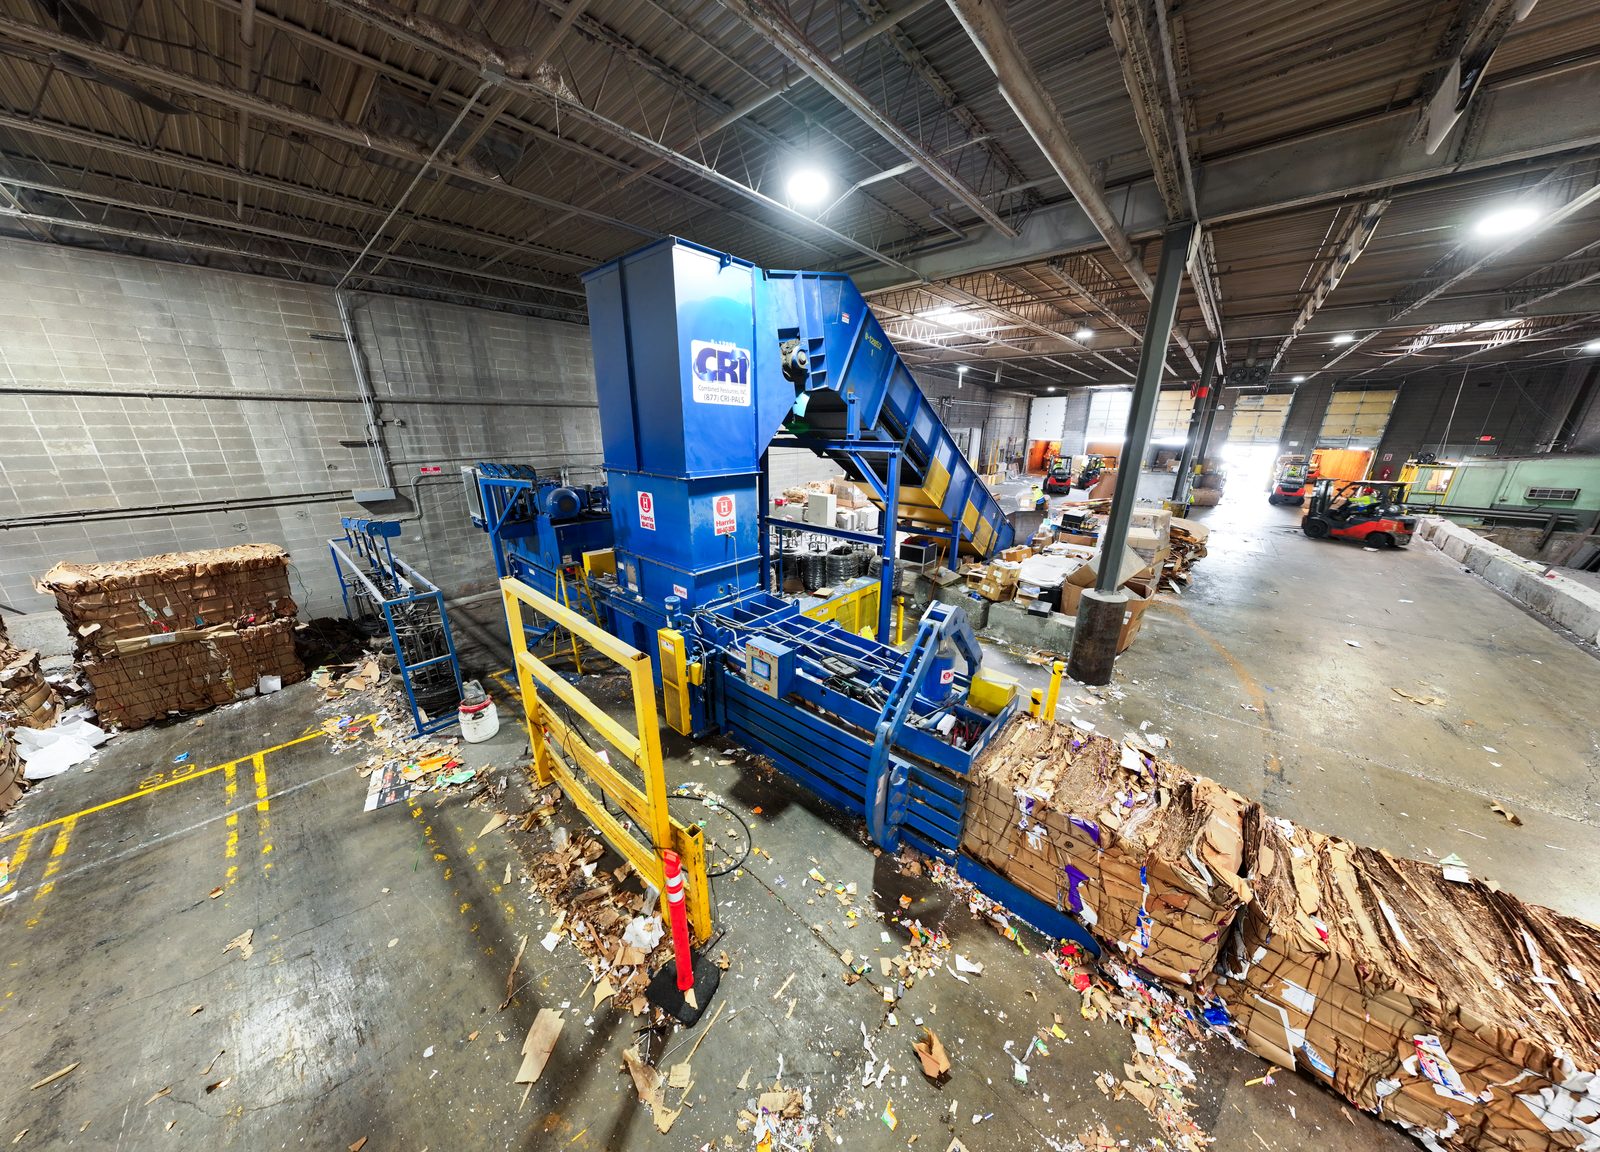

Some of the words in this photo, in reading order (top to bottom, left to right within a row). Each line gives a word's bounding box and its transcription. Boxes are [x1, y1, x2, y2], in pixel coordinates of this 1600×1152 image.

[695, 347, 748, 385] CRI
[703, 393, 720, 402] (877)
[720, 394, 745, 404] CRI-PALS
[640, 514, 654, 523] Harris
[715, 518, 735, 528] Harris
